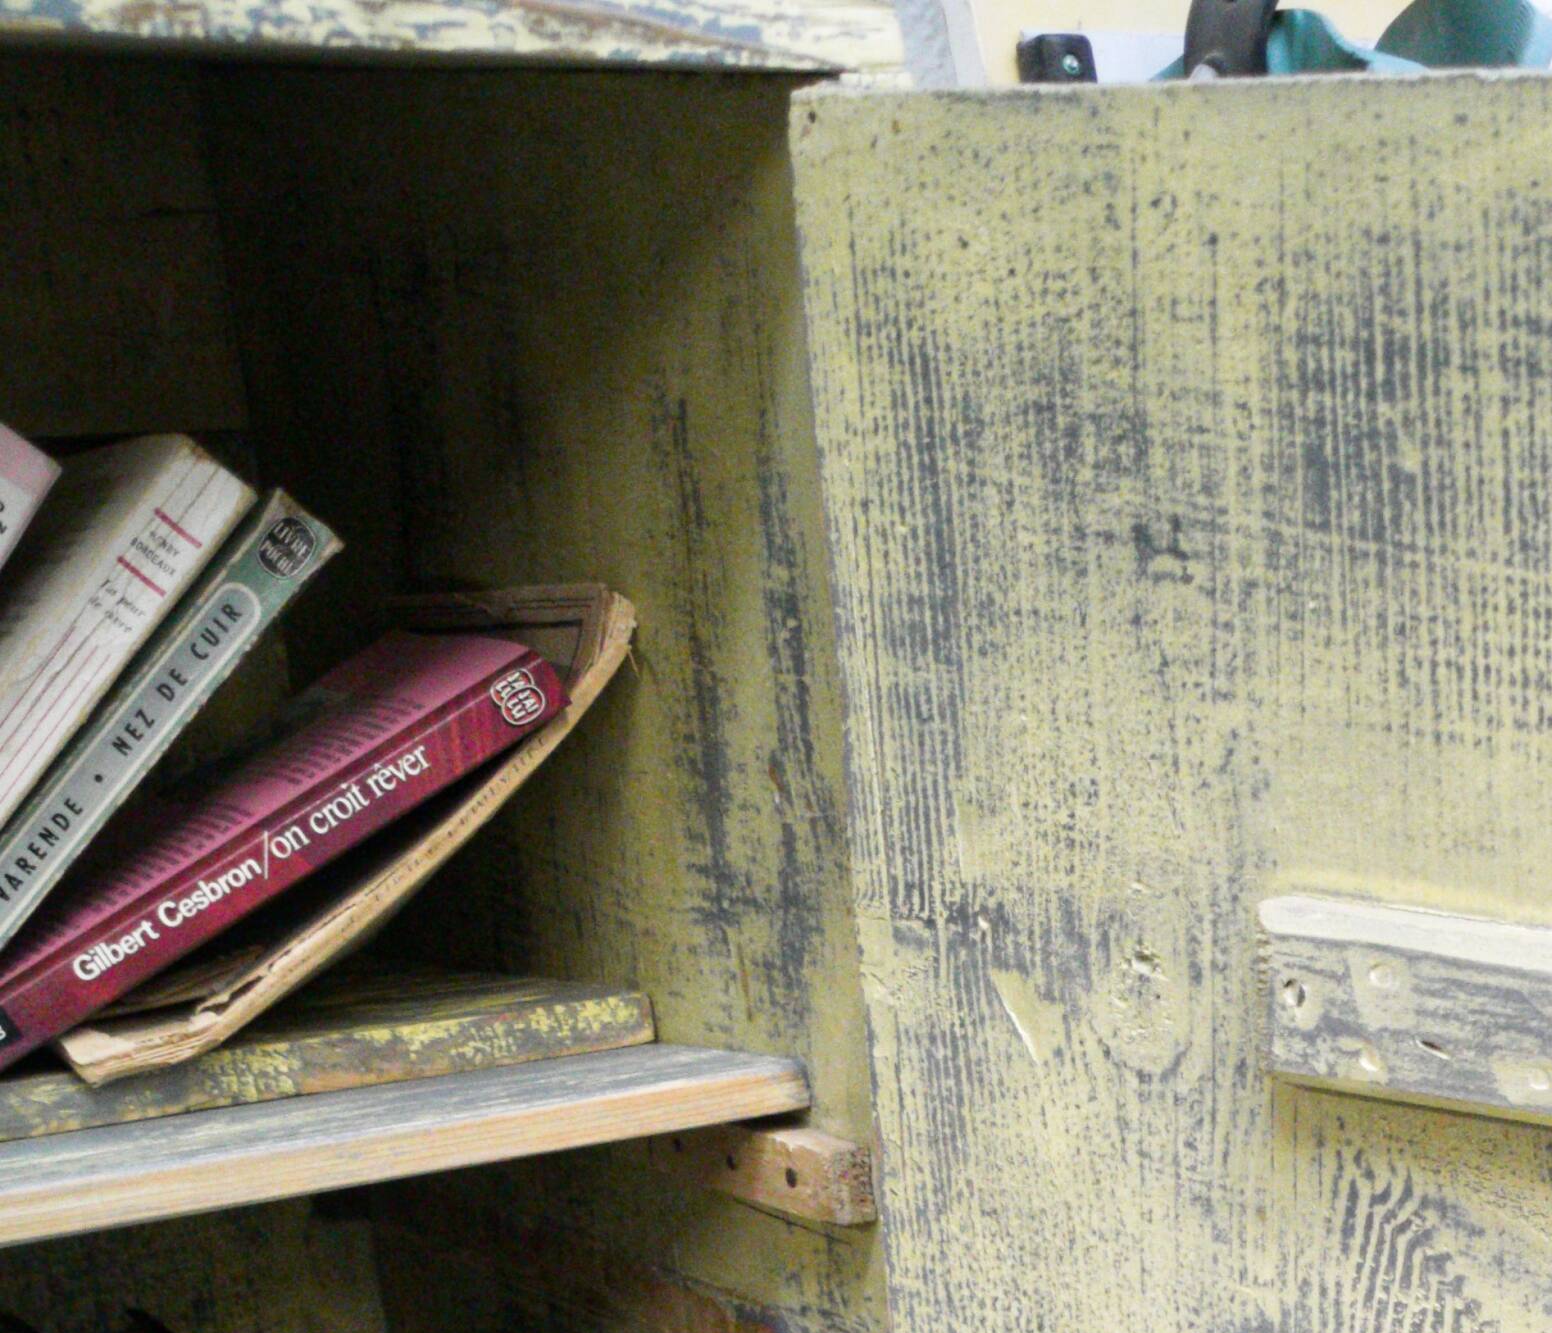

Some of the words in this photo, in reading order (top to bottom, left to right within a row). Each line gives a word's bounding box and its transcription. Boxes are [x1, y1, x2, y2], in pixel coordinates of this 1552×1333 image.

[130, 536, 177, 576] BORDEAUX
[111, 708, 156, 756] NEZ
[156, 668, 189, 702] DE
[190, 602, 243, 661] CUIR
[72, 919, 160, 981] Gilbert
[309, 782, 371, 835] croit
[366, 745, 431, 800] rêver
